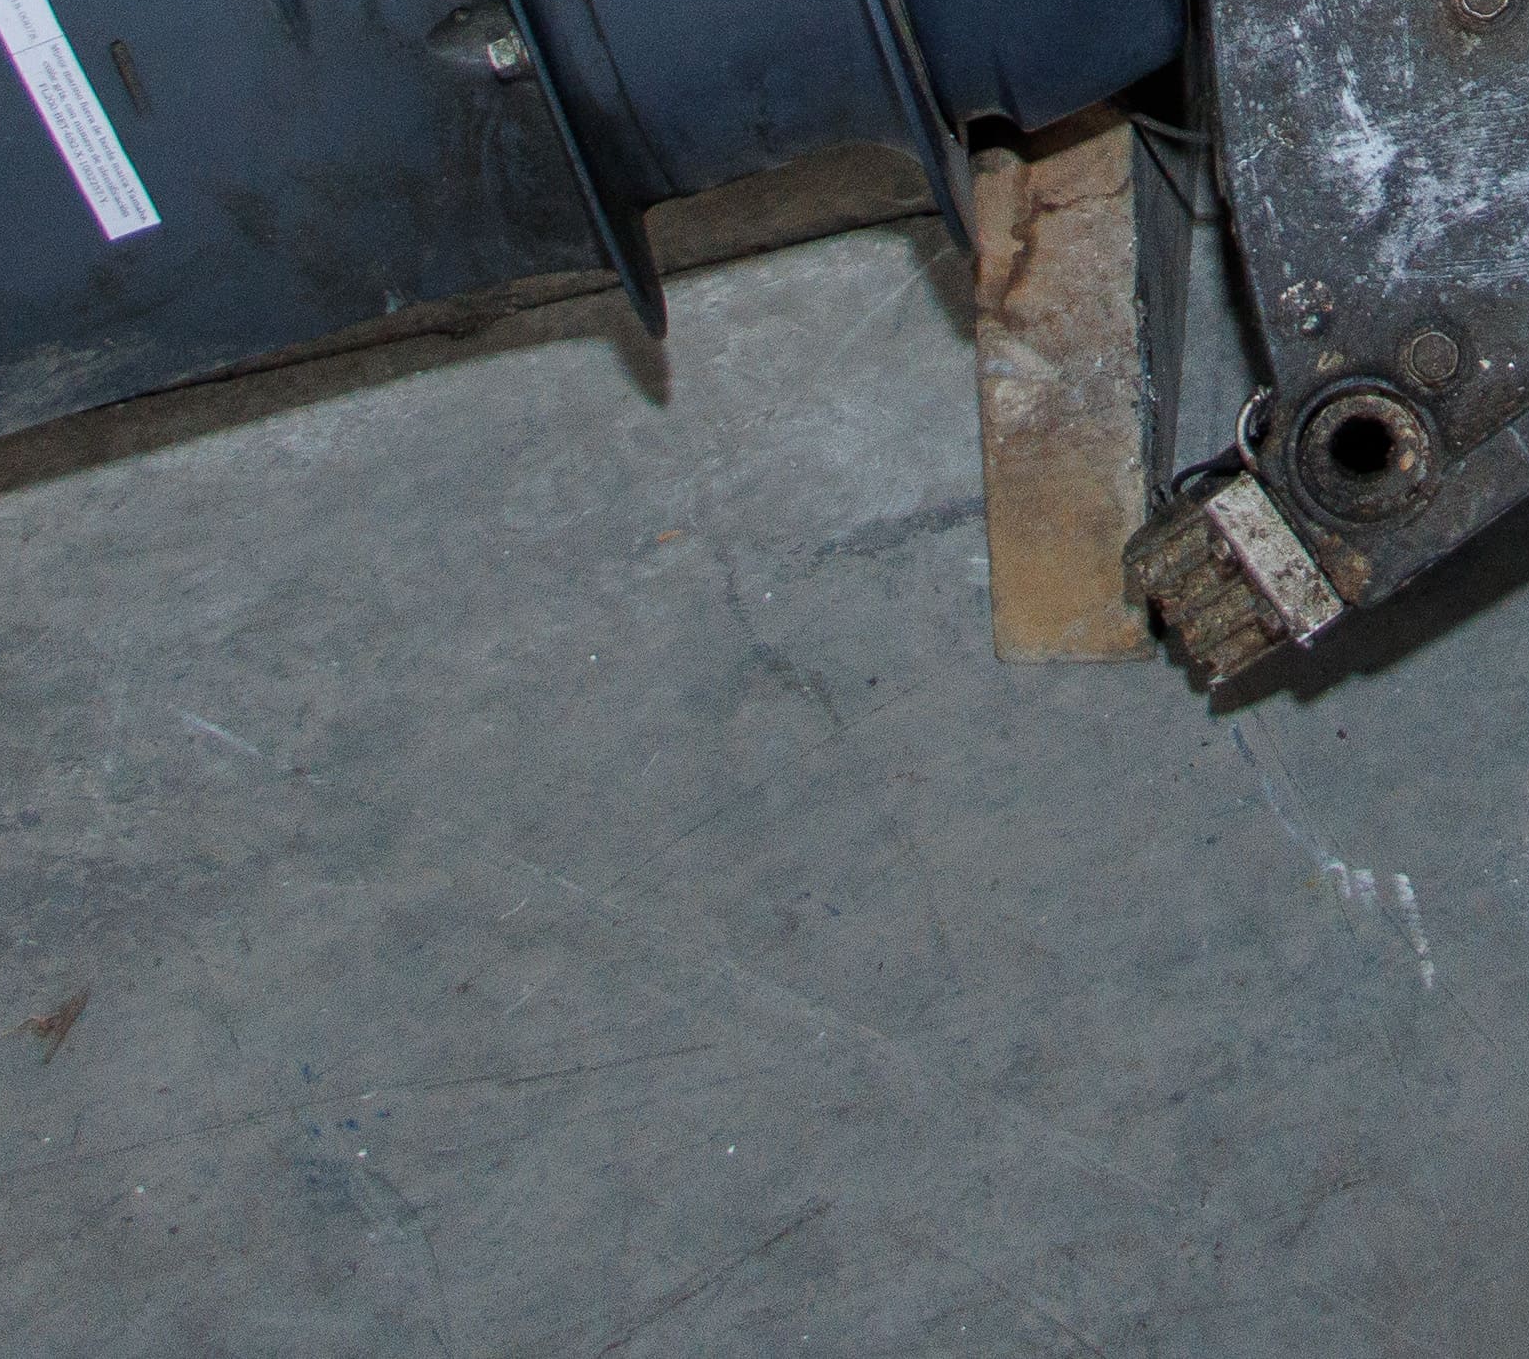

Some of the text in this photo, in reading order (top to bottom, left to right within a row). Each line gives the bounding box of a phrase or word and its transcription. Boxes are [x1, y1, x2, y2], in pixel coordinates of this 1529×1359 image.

[63, 101, 78, 119] con
[90, 152, 104, 164] de
[78, 100, 98, 124] fuera
[91, 123, 105, 136] de
[111, 161, 131, 188] marca
